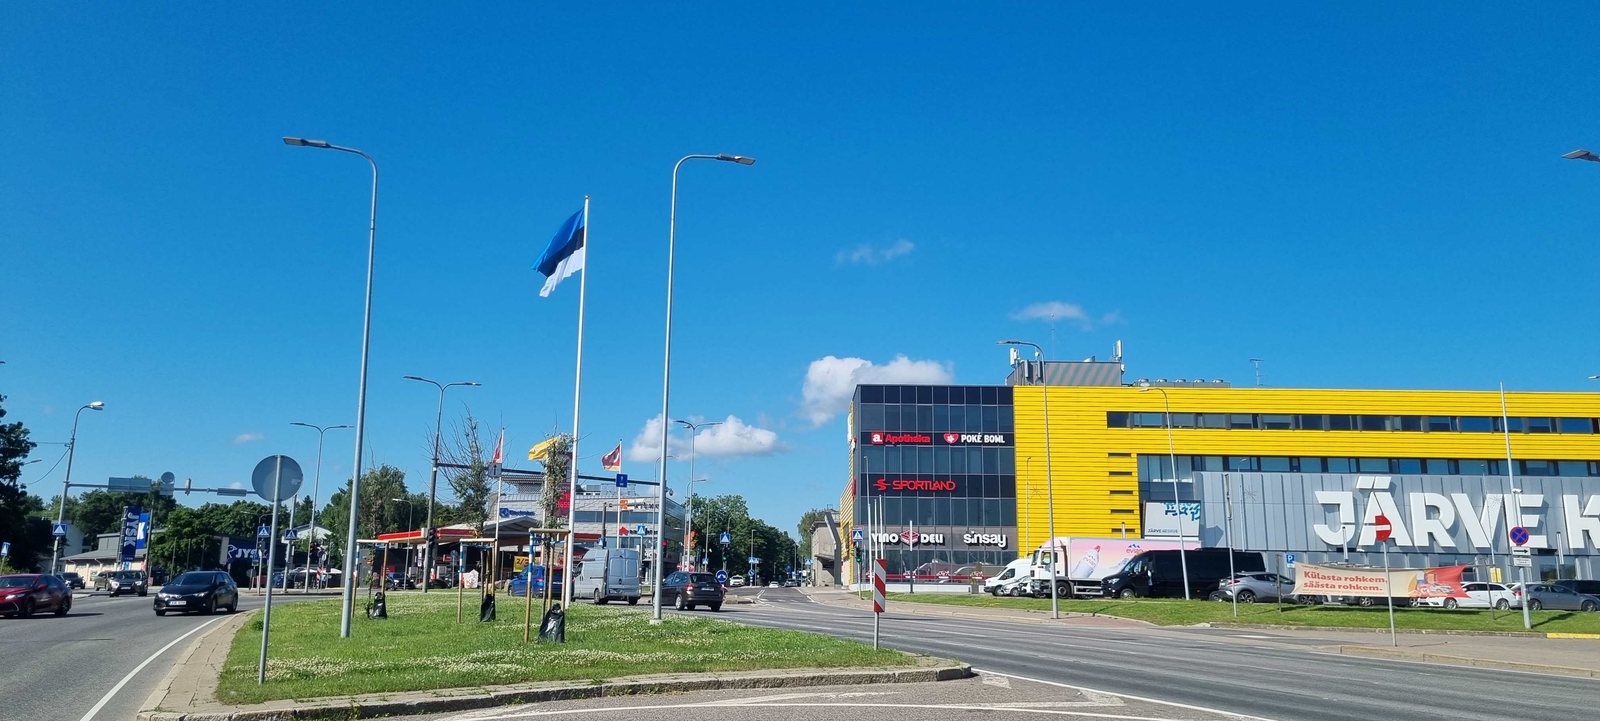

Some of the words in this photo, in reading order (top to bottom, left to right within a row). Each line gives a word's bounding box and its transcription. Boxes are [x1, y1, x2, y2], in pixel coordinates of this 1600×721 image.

[885, 434, 931, 444] Apotheka
[961, 433, 983, 444] POKÉ
[984, 434, 1006, 444] BOWL
[892, 480, 957, 491] SPORTLAND
[1313, 476, 1548, 549] JÄRVE
[124, 512, 140, 547] JYSK
[920, 533, 944, 544] DELI
[963, 530, 1007, 548] sinsay
[235, 548, 268, 559] JYS
[1303, 571, 1342, 582] Külasta
[1303, 581, 1336, 589] säästa
[1338, 583, 1383, 591] rohkem.
